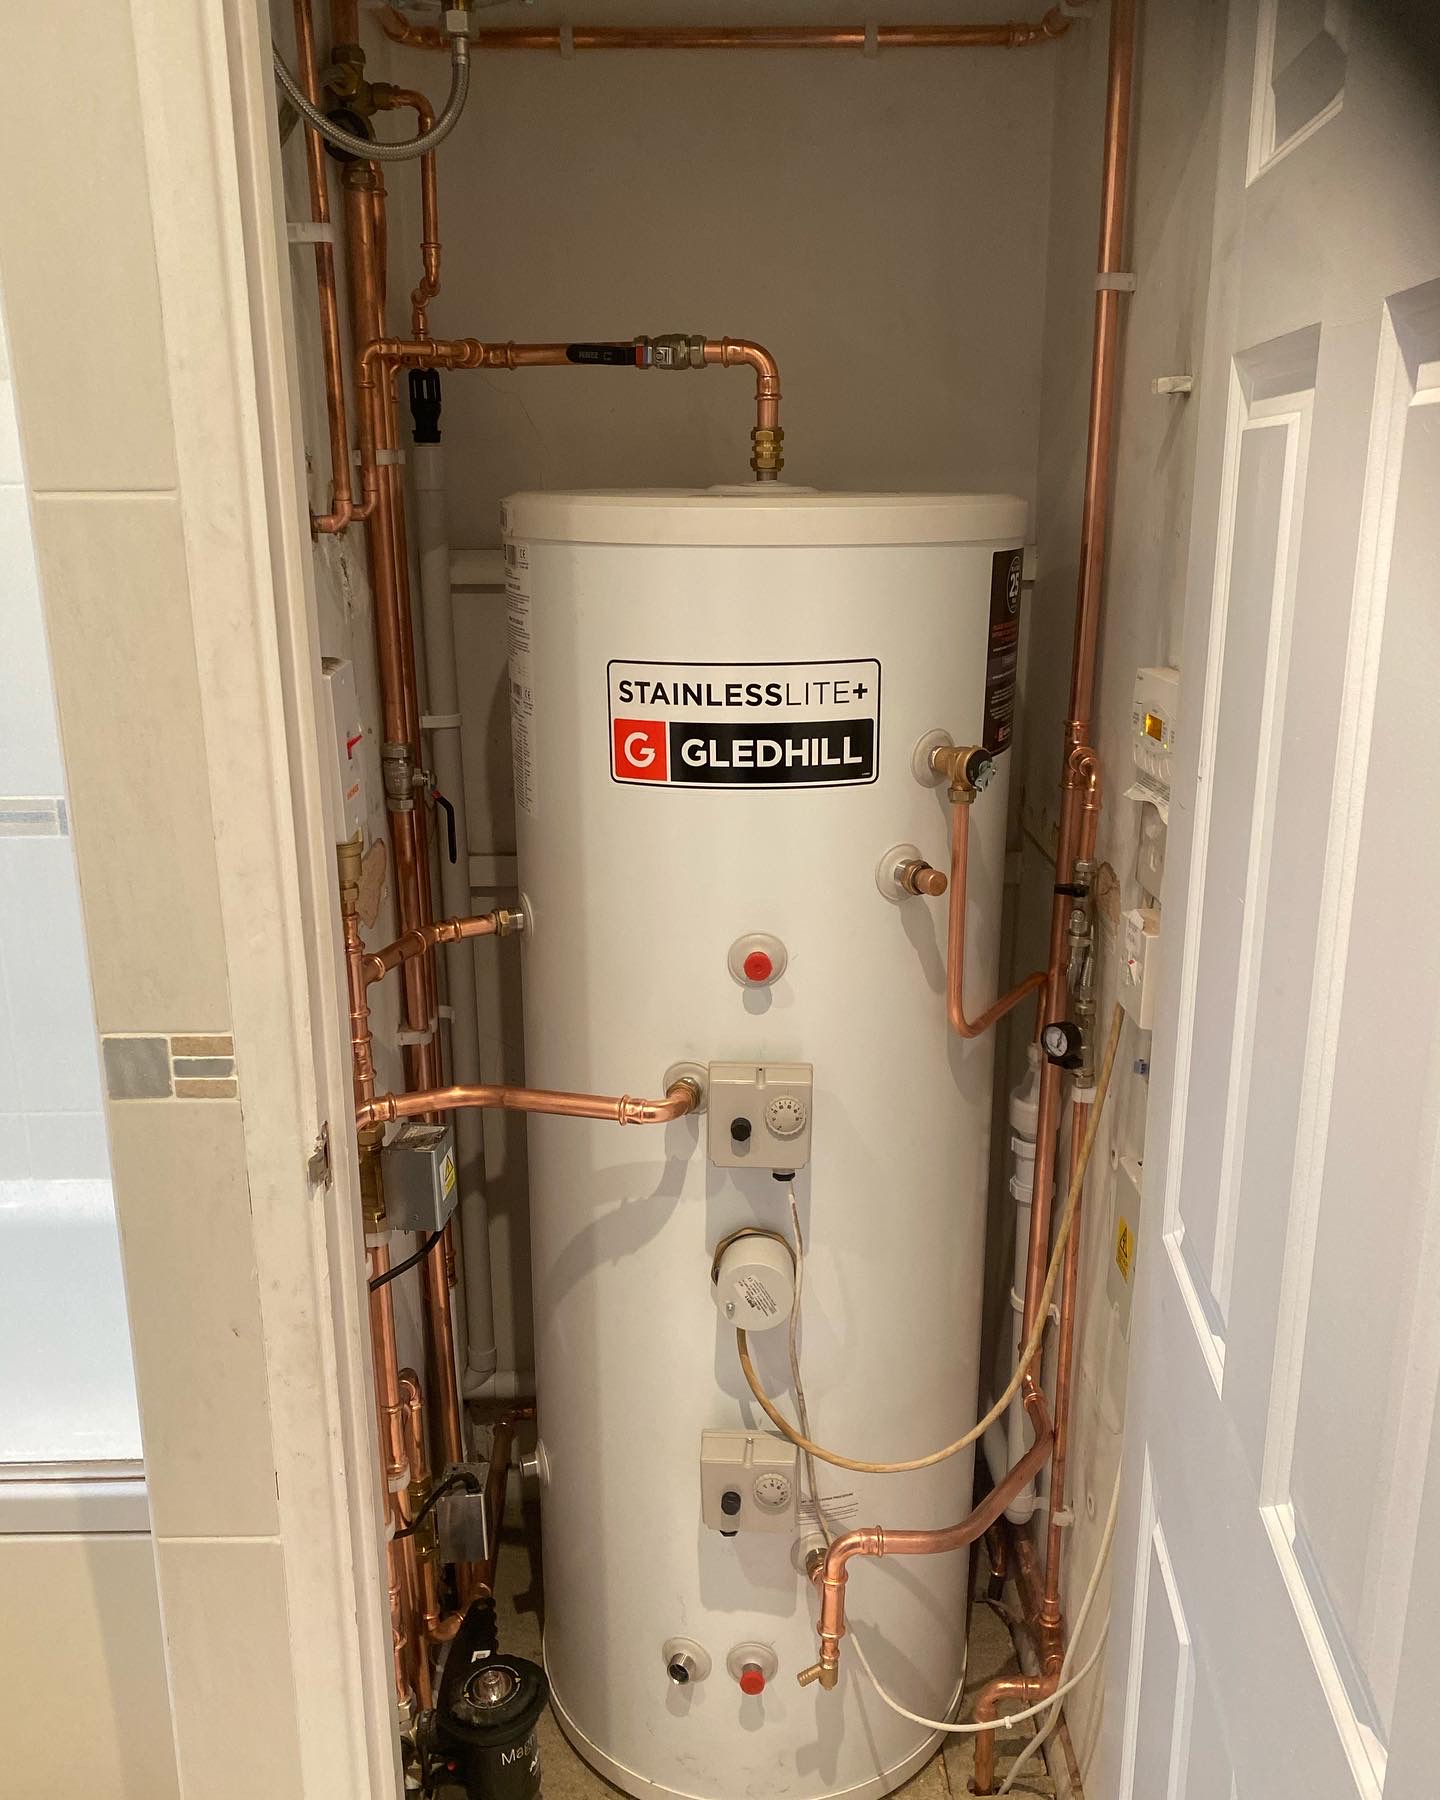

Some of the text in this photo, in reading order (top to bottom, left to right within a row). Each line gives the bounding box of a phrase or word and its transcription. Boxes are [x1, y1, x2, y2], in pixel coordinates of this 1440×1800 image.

[618, 680, 868, 706] STAINLESSLITE+
[623, 731, 656, 768] G
[681, 736, 863, 768] GLEDHILL
